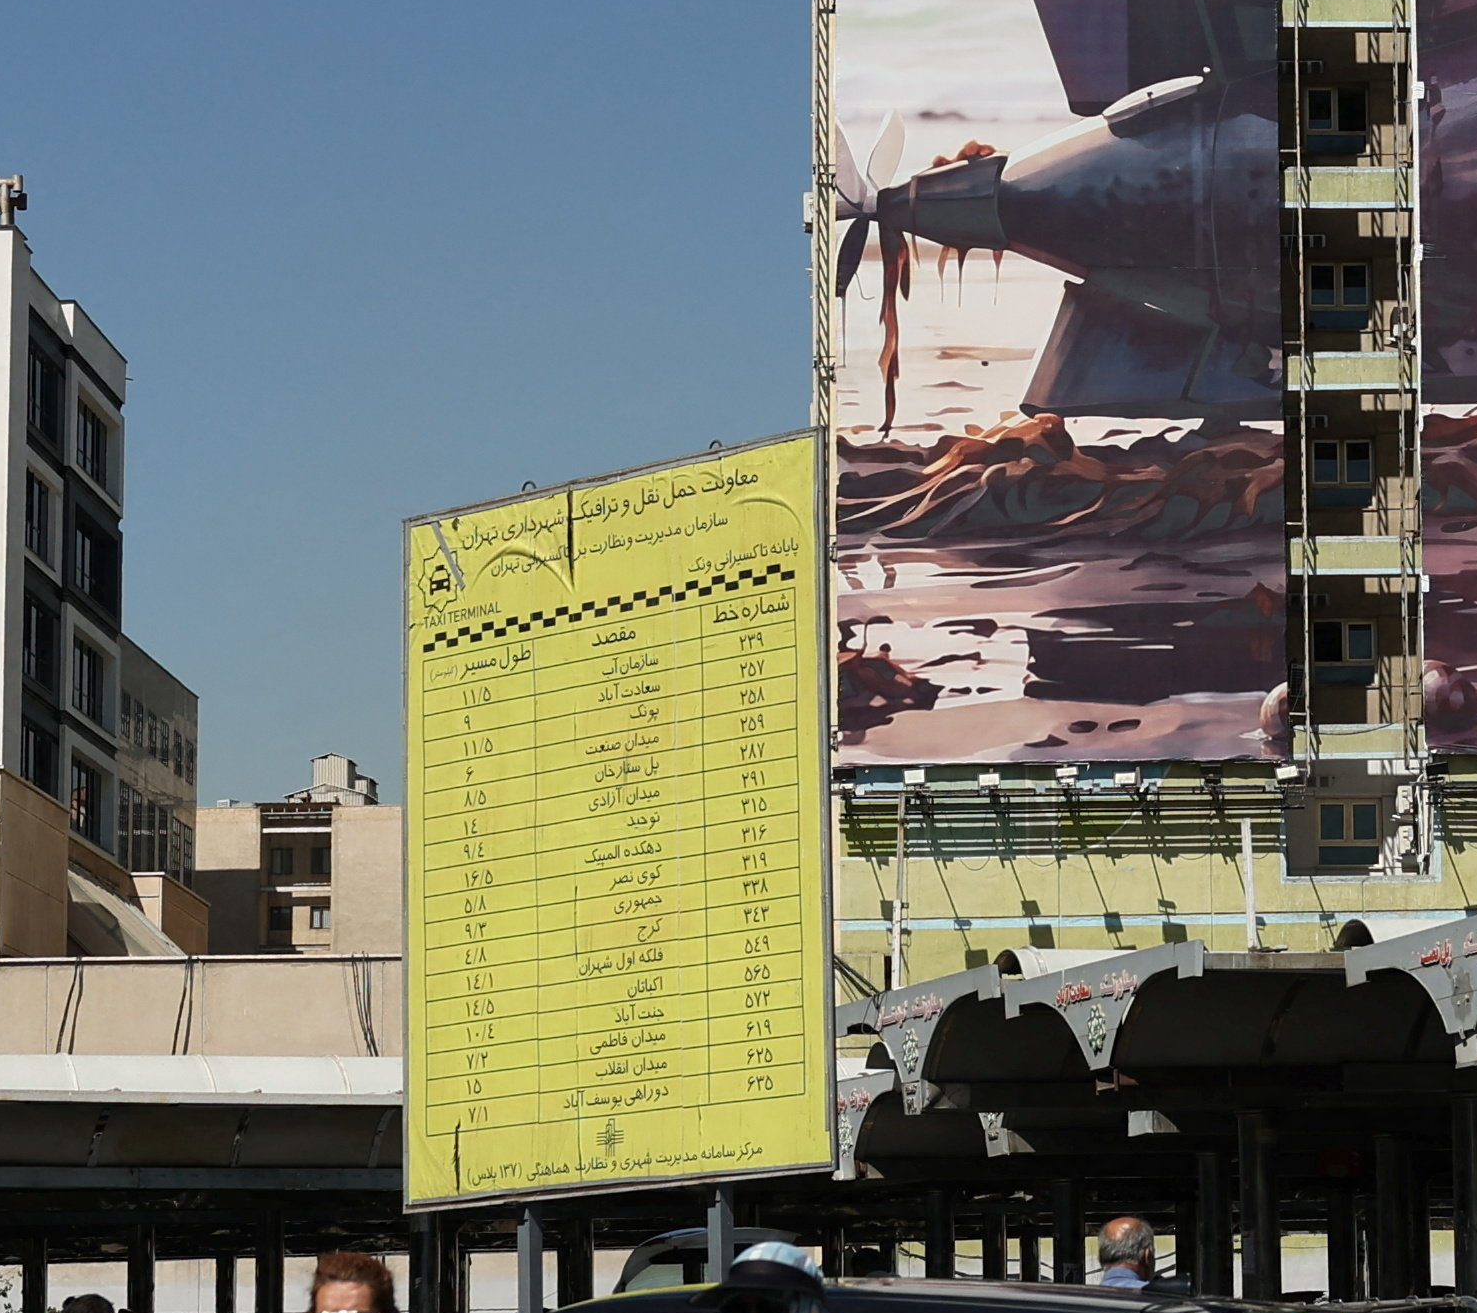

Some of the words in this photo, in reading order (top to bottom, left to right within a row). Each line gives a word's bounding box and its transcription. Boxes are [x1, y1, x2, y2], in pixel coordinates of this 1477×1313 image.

[701, 468, 759, 496] معاونت
[633, 488, 660, 516] نقل
[663, 480, 698, 509] حمل
[572, 496, 621, 524] ترافیک
[620, 499, 630, 518] و
[501, 508, 566, 541] شهرداری
[683, 513, 729, 537] سازمان
[461, 525, 499, 552] تهران
[589, 534, 626, 556] نظارت
[624, 536, 634, 552] و
[634, 525, 683, 547] مدیریت
[572, 546, 588, 563] بر
[714, 542, 769, 571] تاکسیرانی
[770, 537, 800, 557] پایانه
[490, 557, 521, 578] تهران
[687, 556, 713, 575] ونک
[424, 613, 446, 629] TAXI
[447, 601, 502, 624] TERMINAL
[712, 604, 740, 624] خط
[741, 593, 790, 622] شماره
[591, 626, 637, 647] مقصد
[498, 643, 532, 673] طول
[602, 656, 619, 679] آب
[620, 652, 659, 675] سازمان
[459, 657, 497, 681] مسیر
[739, 658, 765, 679] ۲۵۷
[462, 685, 492, 706] ۱۱/۵
[598, 682, 620, 704] آباد
[621, 680, 660, 698] سعادت
[739, 685, 766, 706] ۲۵۸
[463, 714, 472, 731] ۹
[629, 704, 659, 723] پونک
[739, 712, 765, 733] ۲۵۹
[463, 737, 494, 757] ۱۱/۵
[585, 741, 621, 755] صنعت
[624, 732, 659, 751] میدان
[739, 741, 765, 761] ۲۸۷
[465, 765, 475, 784] ۶
[644, 756, 660, 777] پل
[740, 769, 766, 789] ۲۹۱
[464, 789, 487, 808] ۸/۵
[588, 786, 622, 812] آزادی
[626, 786, 660, 806] میدان
[740, 796, 768, 815] ۳۱۵
[627, 811, 661, 830] توحید
[740, 823, 768, 843] ۳۱۶
[584, 844, 620, 866] المپیک
[624, 840, 662, 857] دهکده
[741, 851, 768, 871] ۳۱۹
[464, 868, 495, 889] ۱۶/۵
[609, 871, 634, 891] نصر
[637, 864, 662, 886] کوی
[741, 877, 769, 897] ۳۳۸
[463, 893, 487, 914] ۵/۸
[614, 895, 663, 914] جمهوری
[464, 921, 488, 940] ۹/۳
[637, 918, 663, 942] کرج
[616, 950, 635, 971] اول
[639, 948, 664, 963] فلکه
[579, 956, 612, 976] شهران
[743, 963, 771, 983] ۵۶۵
[627, 976, 663, 998] اکباتان
[744, 989, 771, 1009] ۵۷۲
[615, 1003, 637, 1025] آباد
[638, 1007, 665, 1021] جنت
[745, 1018, 772, 1038] ۶۱۹
[590, 1032, 628, 1055] فاطمی
[632, 1029, 666, 1048] میدان
[465, 1050, 489, 1071] ۷/۲
[595, 1059, 629, 1080] انقلاب
[633, 1057, 668, 1076] میدان
[466, 1078, 482, 1096] ۱۵
[624, 1084, 669, 1107] دوراهی
[563, 1090, 585, 1112] آباد
[586, 1093, 623, 1111] یوسف
[467, 1105, 489, 1124] ۷/۱
[619, 1152, 653, 1171] شهری
[655, 1151, 698, 1167] مدیریت
[700, 1145, 736, 1161] سامانه
[736, 1141, 764, 1162] مرکز
[525, 1161, 571, 1182] هماهنگی
[574, 1156, 608, 1173] نظارت
[609, 1159, 618, 1173] و
[466, 1165, 497, 1187] پلاس)
